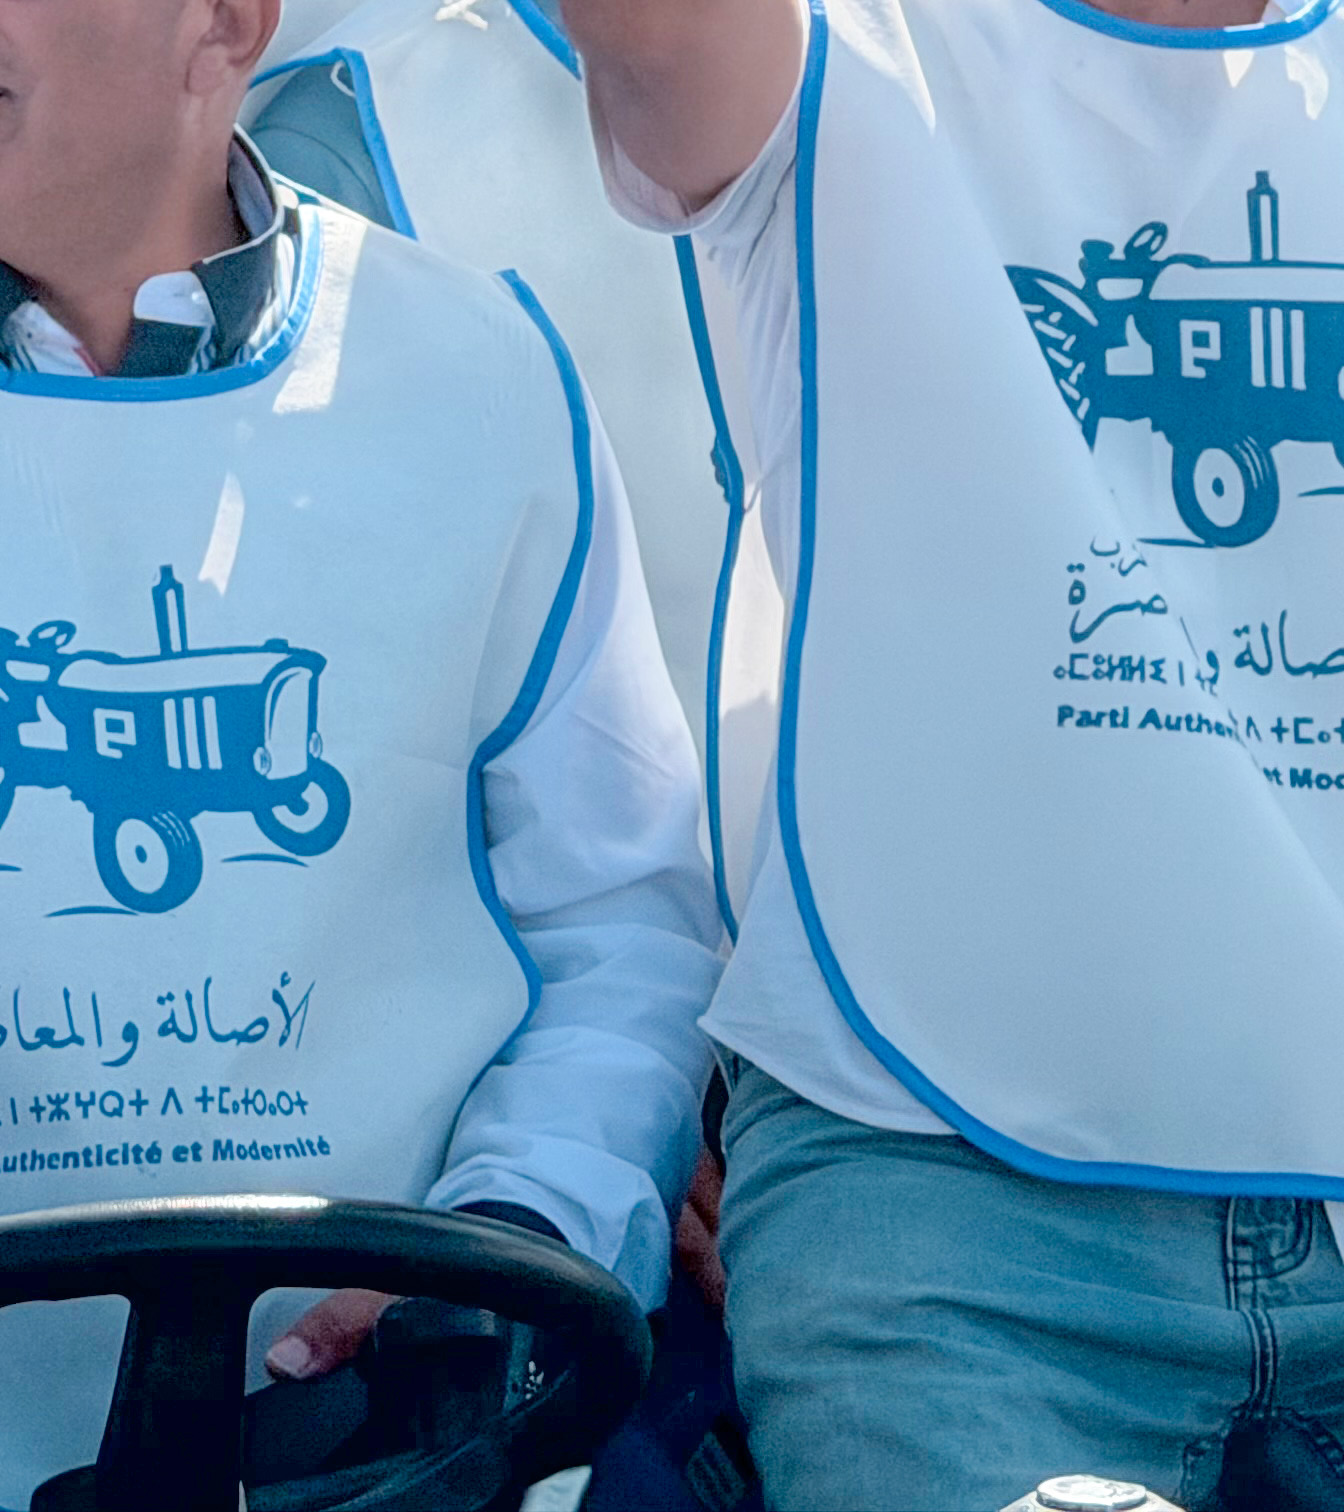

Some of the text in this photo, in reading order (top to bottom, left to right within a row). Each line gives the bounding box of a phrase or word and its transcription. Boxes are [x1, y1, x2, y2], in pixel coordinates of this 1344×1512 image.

[1057, 705, 1130, 728] Parti
[156, 971, 316, 1050] الأصالة
[172, 1141, 203, 1164] et
[212, 1135, 331, 1162] Modernité
